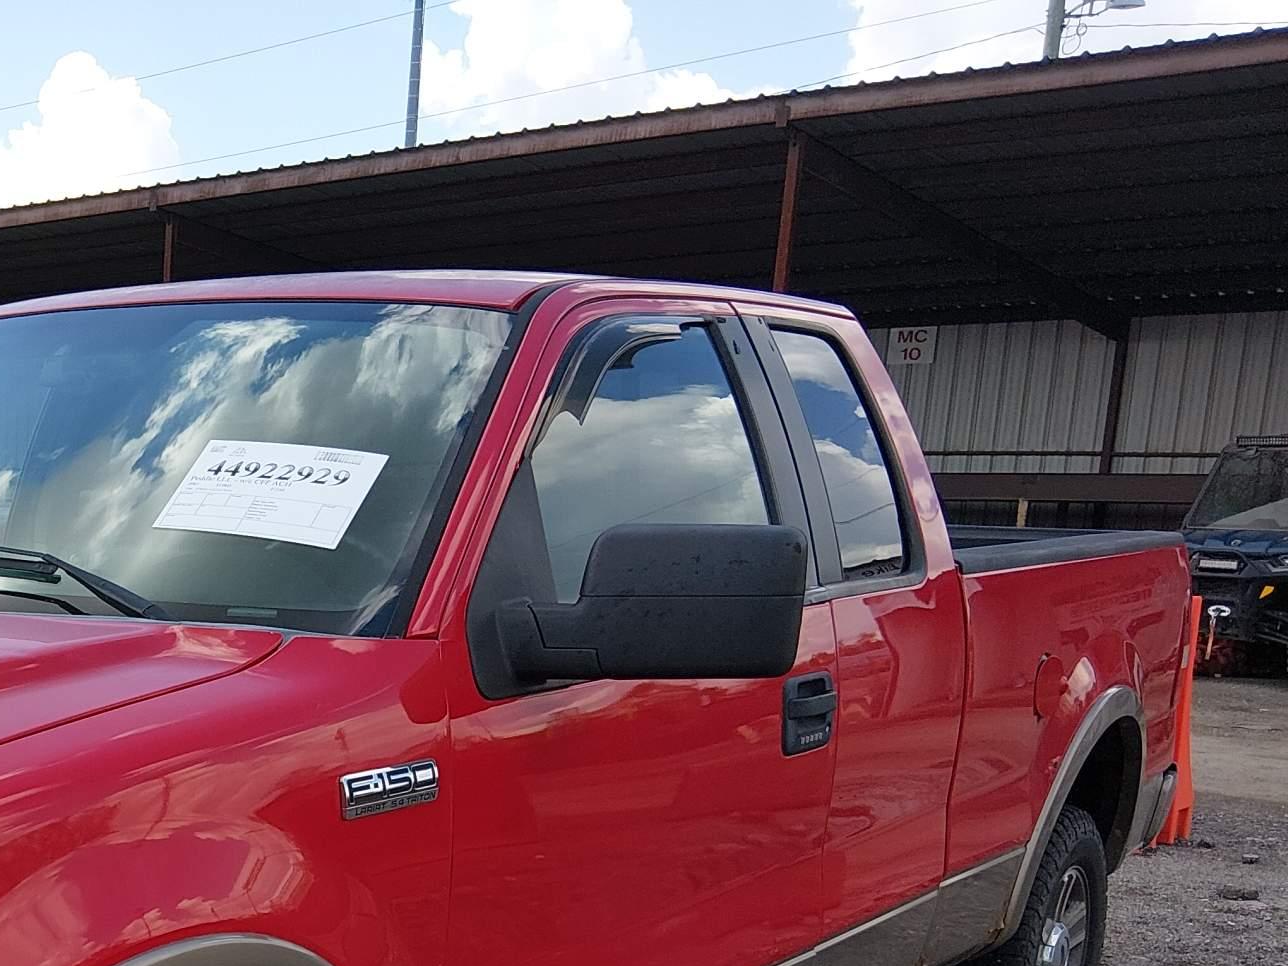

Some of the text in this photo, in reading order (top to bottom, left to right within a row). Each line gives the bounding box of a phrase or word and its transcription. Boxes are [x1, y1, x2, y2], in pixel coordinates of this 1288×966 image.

[897, 329, 928, 343] MC
[900, 347, 921, 361] 10
[207, 459, 351, 486] 44922929
[355, 802, 386, 816] LARIAT
